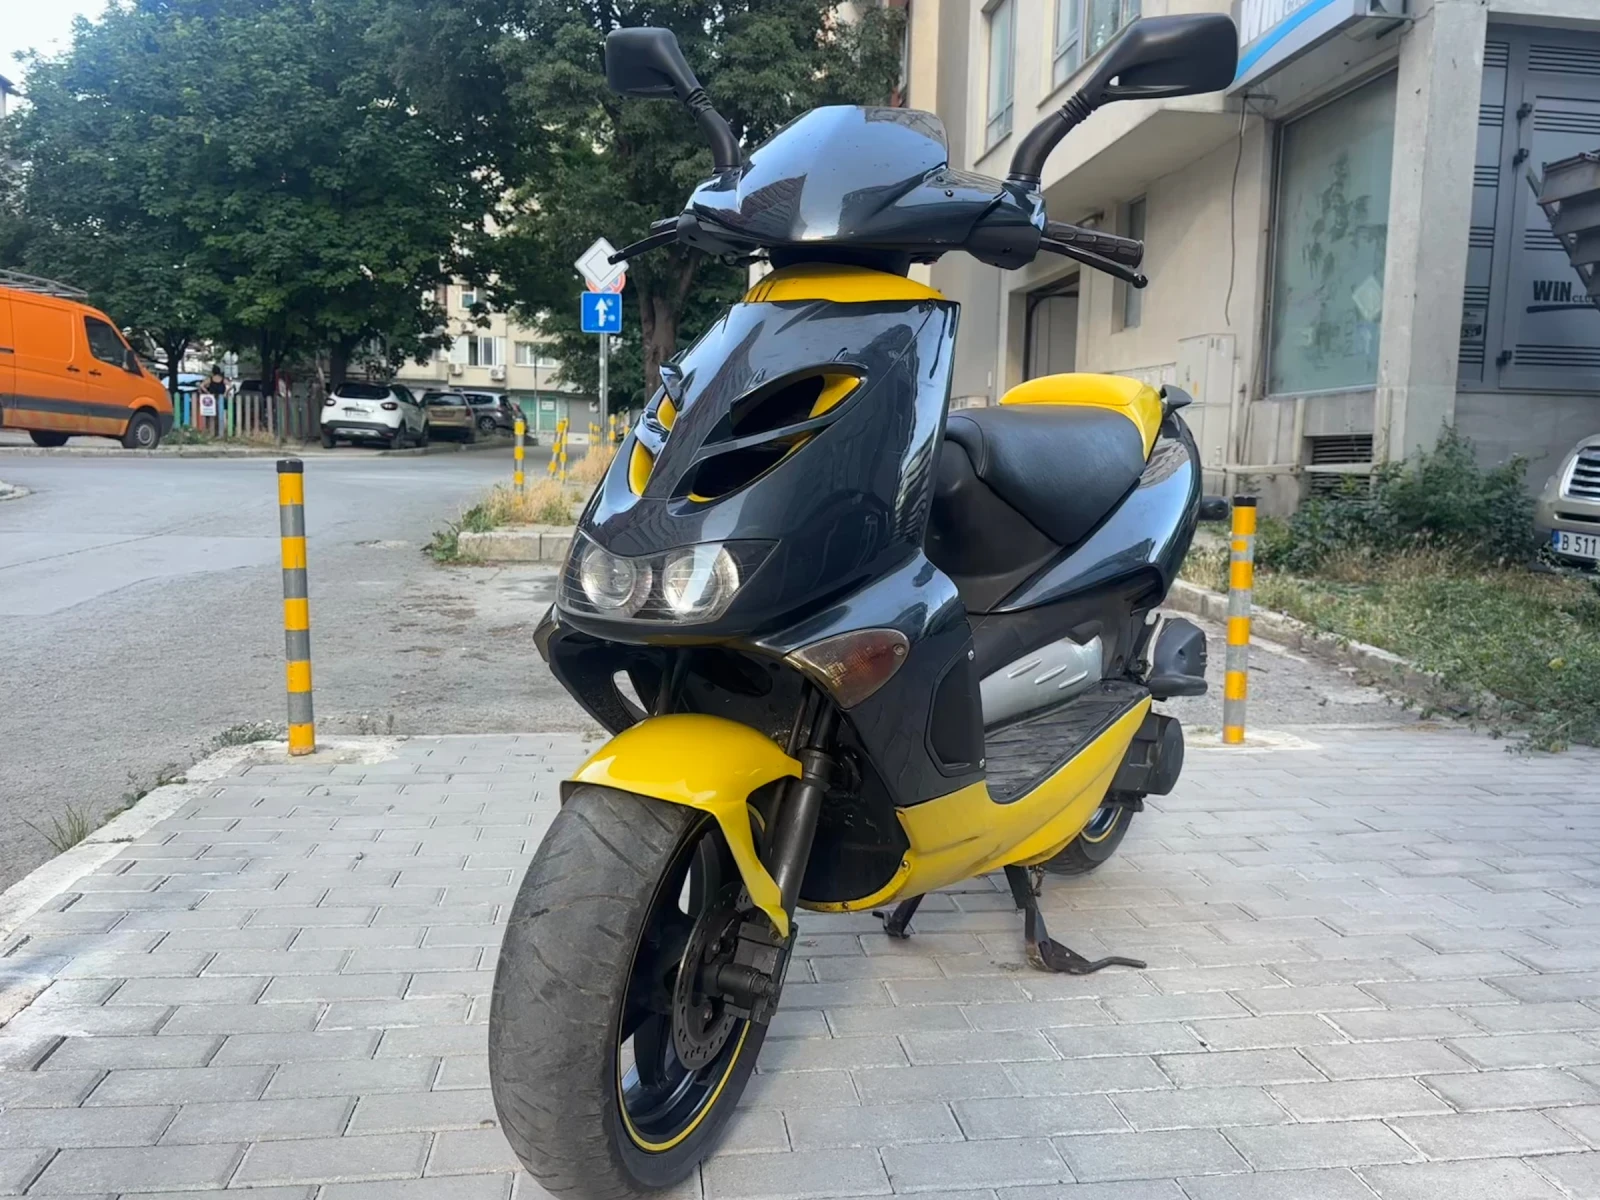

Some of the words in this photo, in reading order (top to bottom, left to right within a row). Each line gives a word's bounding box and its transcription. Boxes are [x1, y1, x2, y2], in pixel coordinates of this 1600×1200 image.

[1240, 0, 1285, 48] WIN
[1533, 280, 1572, 302] WIN
[1561, 534, 1570, 551] B
[1573, 535, 1597, 556] 511
